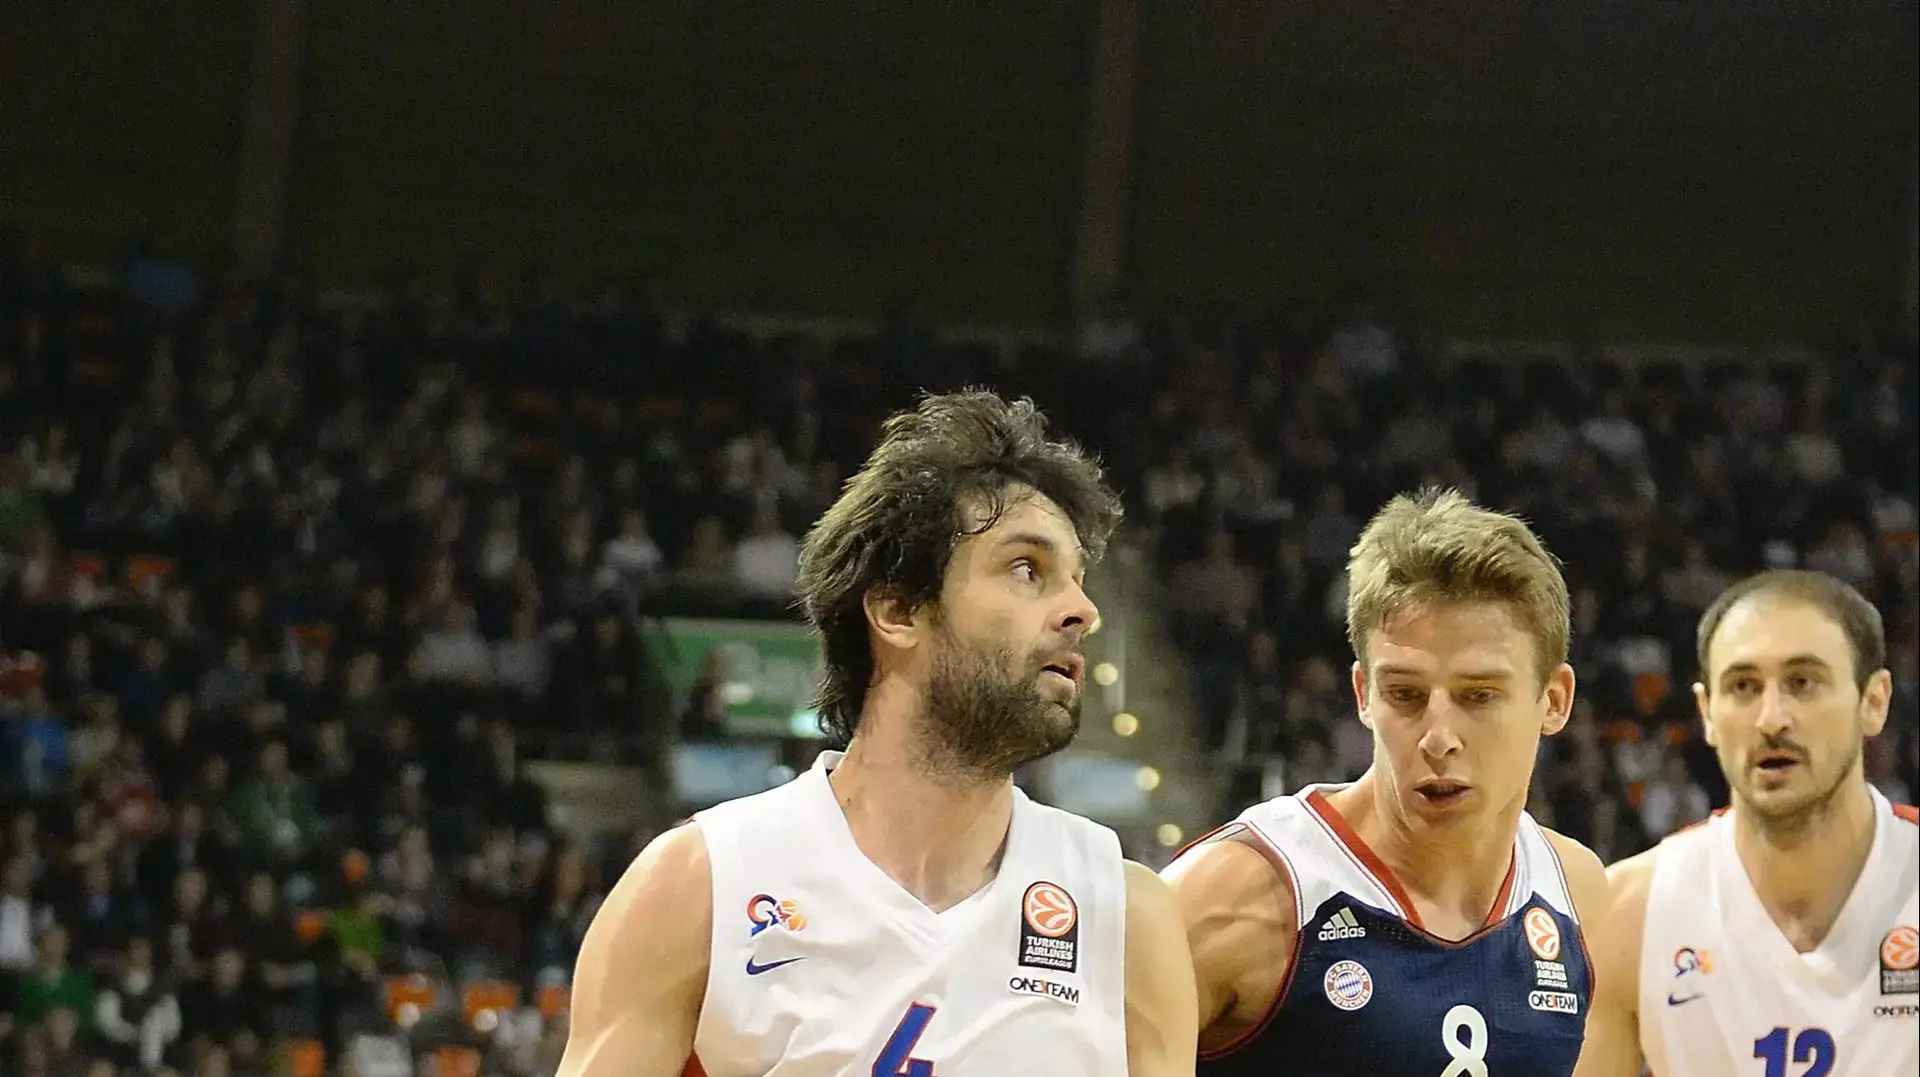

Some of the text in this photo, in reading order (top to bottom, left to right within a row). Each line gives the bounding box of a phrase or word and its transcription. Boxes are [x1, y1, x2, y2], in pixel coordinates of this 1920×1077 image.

[1026, 936, 1074, 951] TURKISH
[1318, 926, 1366, 941] adidas
[1025, 946, 1073, 960] AIRLINES
[871, 1000, 938, 1077] 4
[1440, 1004, 1488, 1077] 8
[1753, 1027, 1836, 1077] 12
